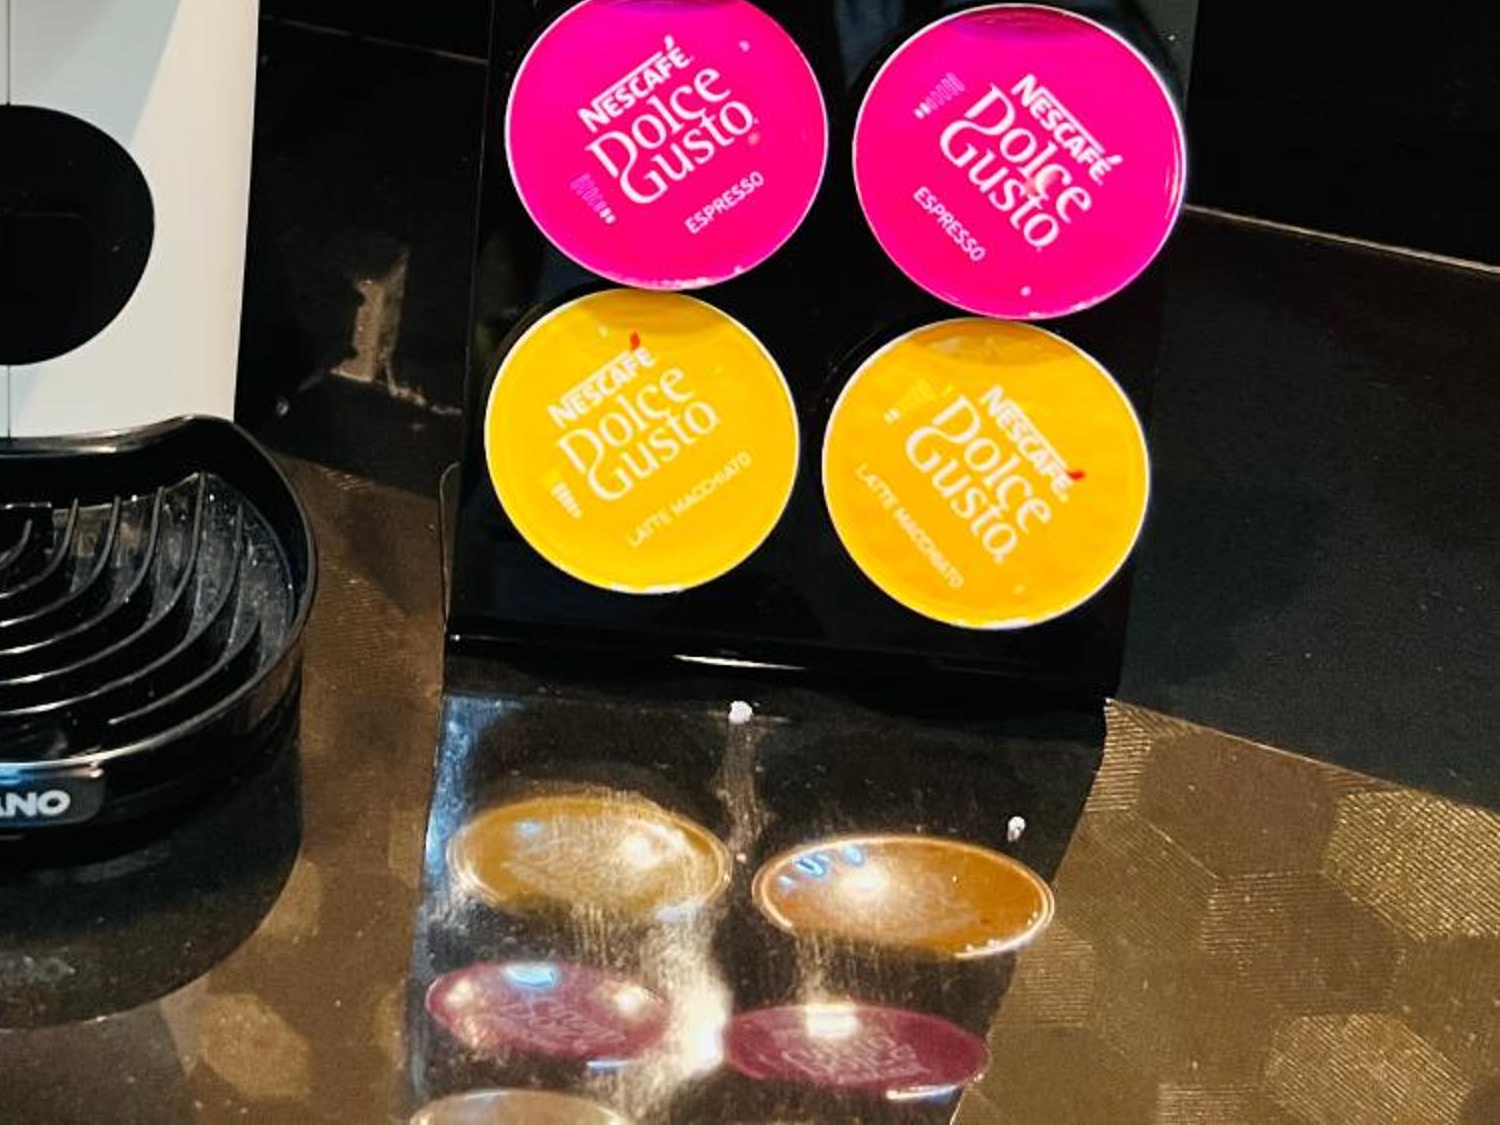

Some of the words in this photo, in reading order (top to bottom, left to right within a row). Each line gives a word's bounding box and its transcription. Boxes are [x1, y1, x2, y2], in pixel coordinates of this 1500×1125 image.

[577, 35, 691, 132] NESCAFÉ
[584, 68, 732, 179] Dolce
[1010, 73, 1124, 186] NESCAFÉ
[619, 100, 754, 204] Gusto
[684, 171, 765, 234] ESPRESSO
[939, 119, 1060, 249] Gusto
[963, 83, 1093, 224] Dolce
[913, 186, 986, 262] ESPRESSO
[547, 331, 657, 428] NESCAFÉ
[557, 367, 695, 474] Dolce
[586, 401, 718, 501] Gusto
[904, 426, 1018, 559] Gusto
[931, 394, 1052, 535] Dolce
